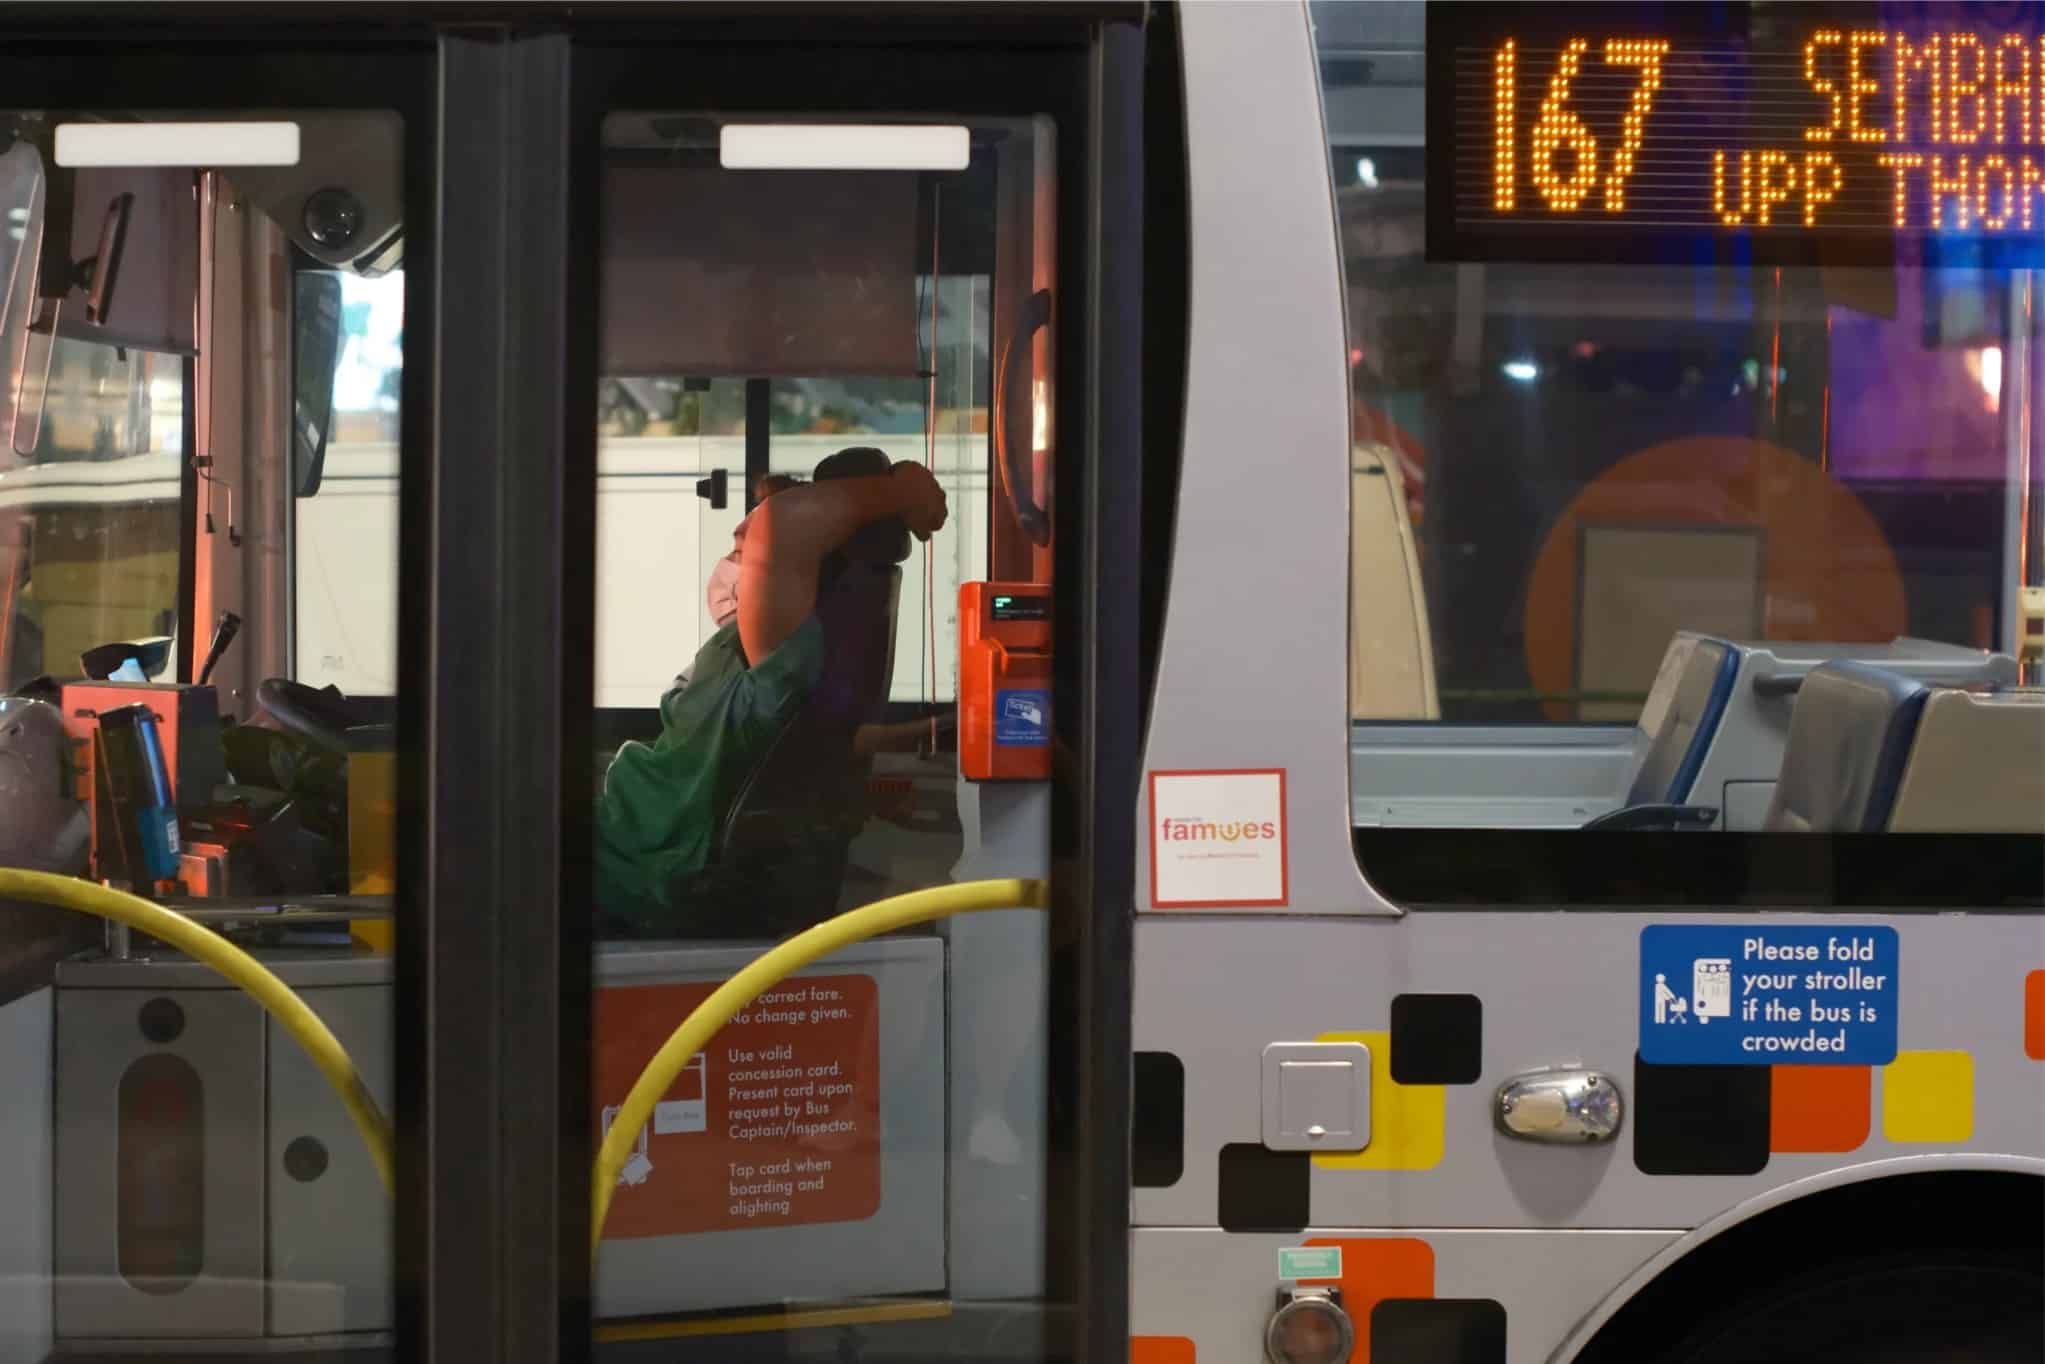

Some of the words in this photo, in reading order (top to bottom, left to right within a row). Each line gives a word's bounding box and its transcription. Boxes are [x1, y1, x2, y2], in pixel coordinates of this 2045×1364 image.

[1805, 30, 2045, 143] SEMBA
[1495, 38, 1671, 211] 167
[1712, 149, 1843, 227] UPP
[1744, 937, 1819, 961] Please
[1828, 937, 1874, 961] fold
[1743, 973, 1797, 995] your
[1805, 967, 1886, 990] stroller
[758, 989, 806, 1004] correct
[811, 986, 843, 1001] fare.
[755, 1008, 806, 1024] change
[811, 1005, 851, 1023] given.
[1743, 998, 1757, 1022] if
[1765, 999, 1802, 1022] the
[1811, 999, 1851, 1022] bus
[1860, 1001, 1877, 1022] is
[1742, 1029, 1845, 1051] crowded
[728, 1048, 753, 1063] Use
[759, 1045, 792, 1061] valid
[728, 1065, 802, 1082] concession
[807, 1062, 842, 1077] card.
[728, 1086, 778, 1101] Present
[783, 1082, 815, 1098] card
[819, 1083, 853, 1101] upon
[728, 1105, 779, 1124] request
[784, 1103, 800, 1119] by
[806, 1100, 829, 1115] Bus
[728, 1121, 857, 1141] Captain/Inspector.
[729, 1162, 754, 1178] Tap
[759, 1158, 790, 1175] card
[794, 1158, 831, 1173] when
[729, 1179, 792, 1197] boarding
[797, 1176, 824, 1191] and
[729, 1199, 789, 1217] alighting
